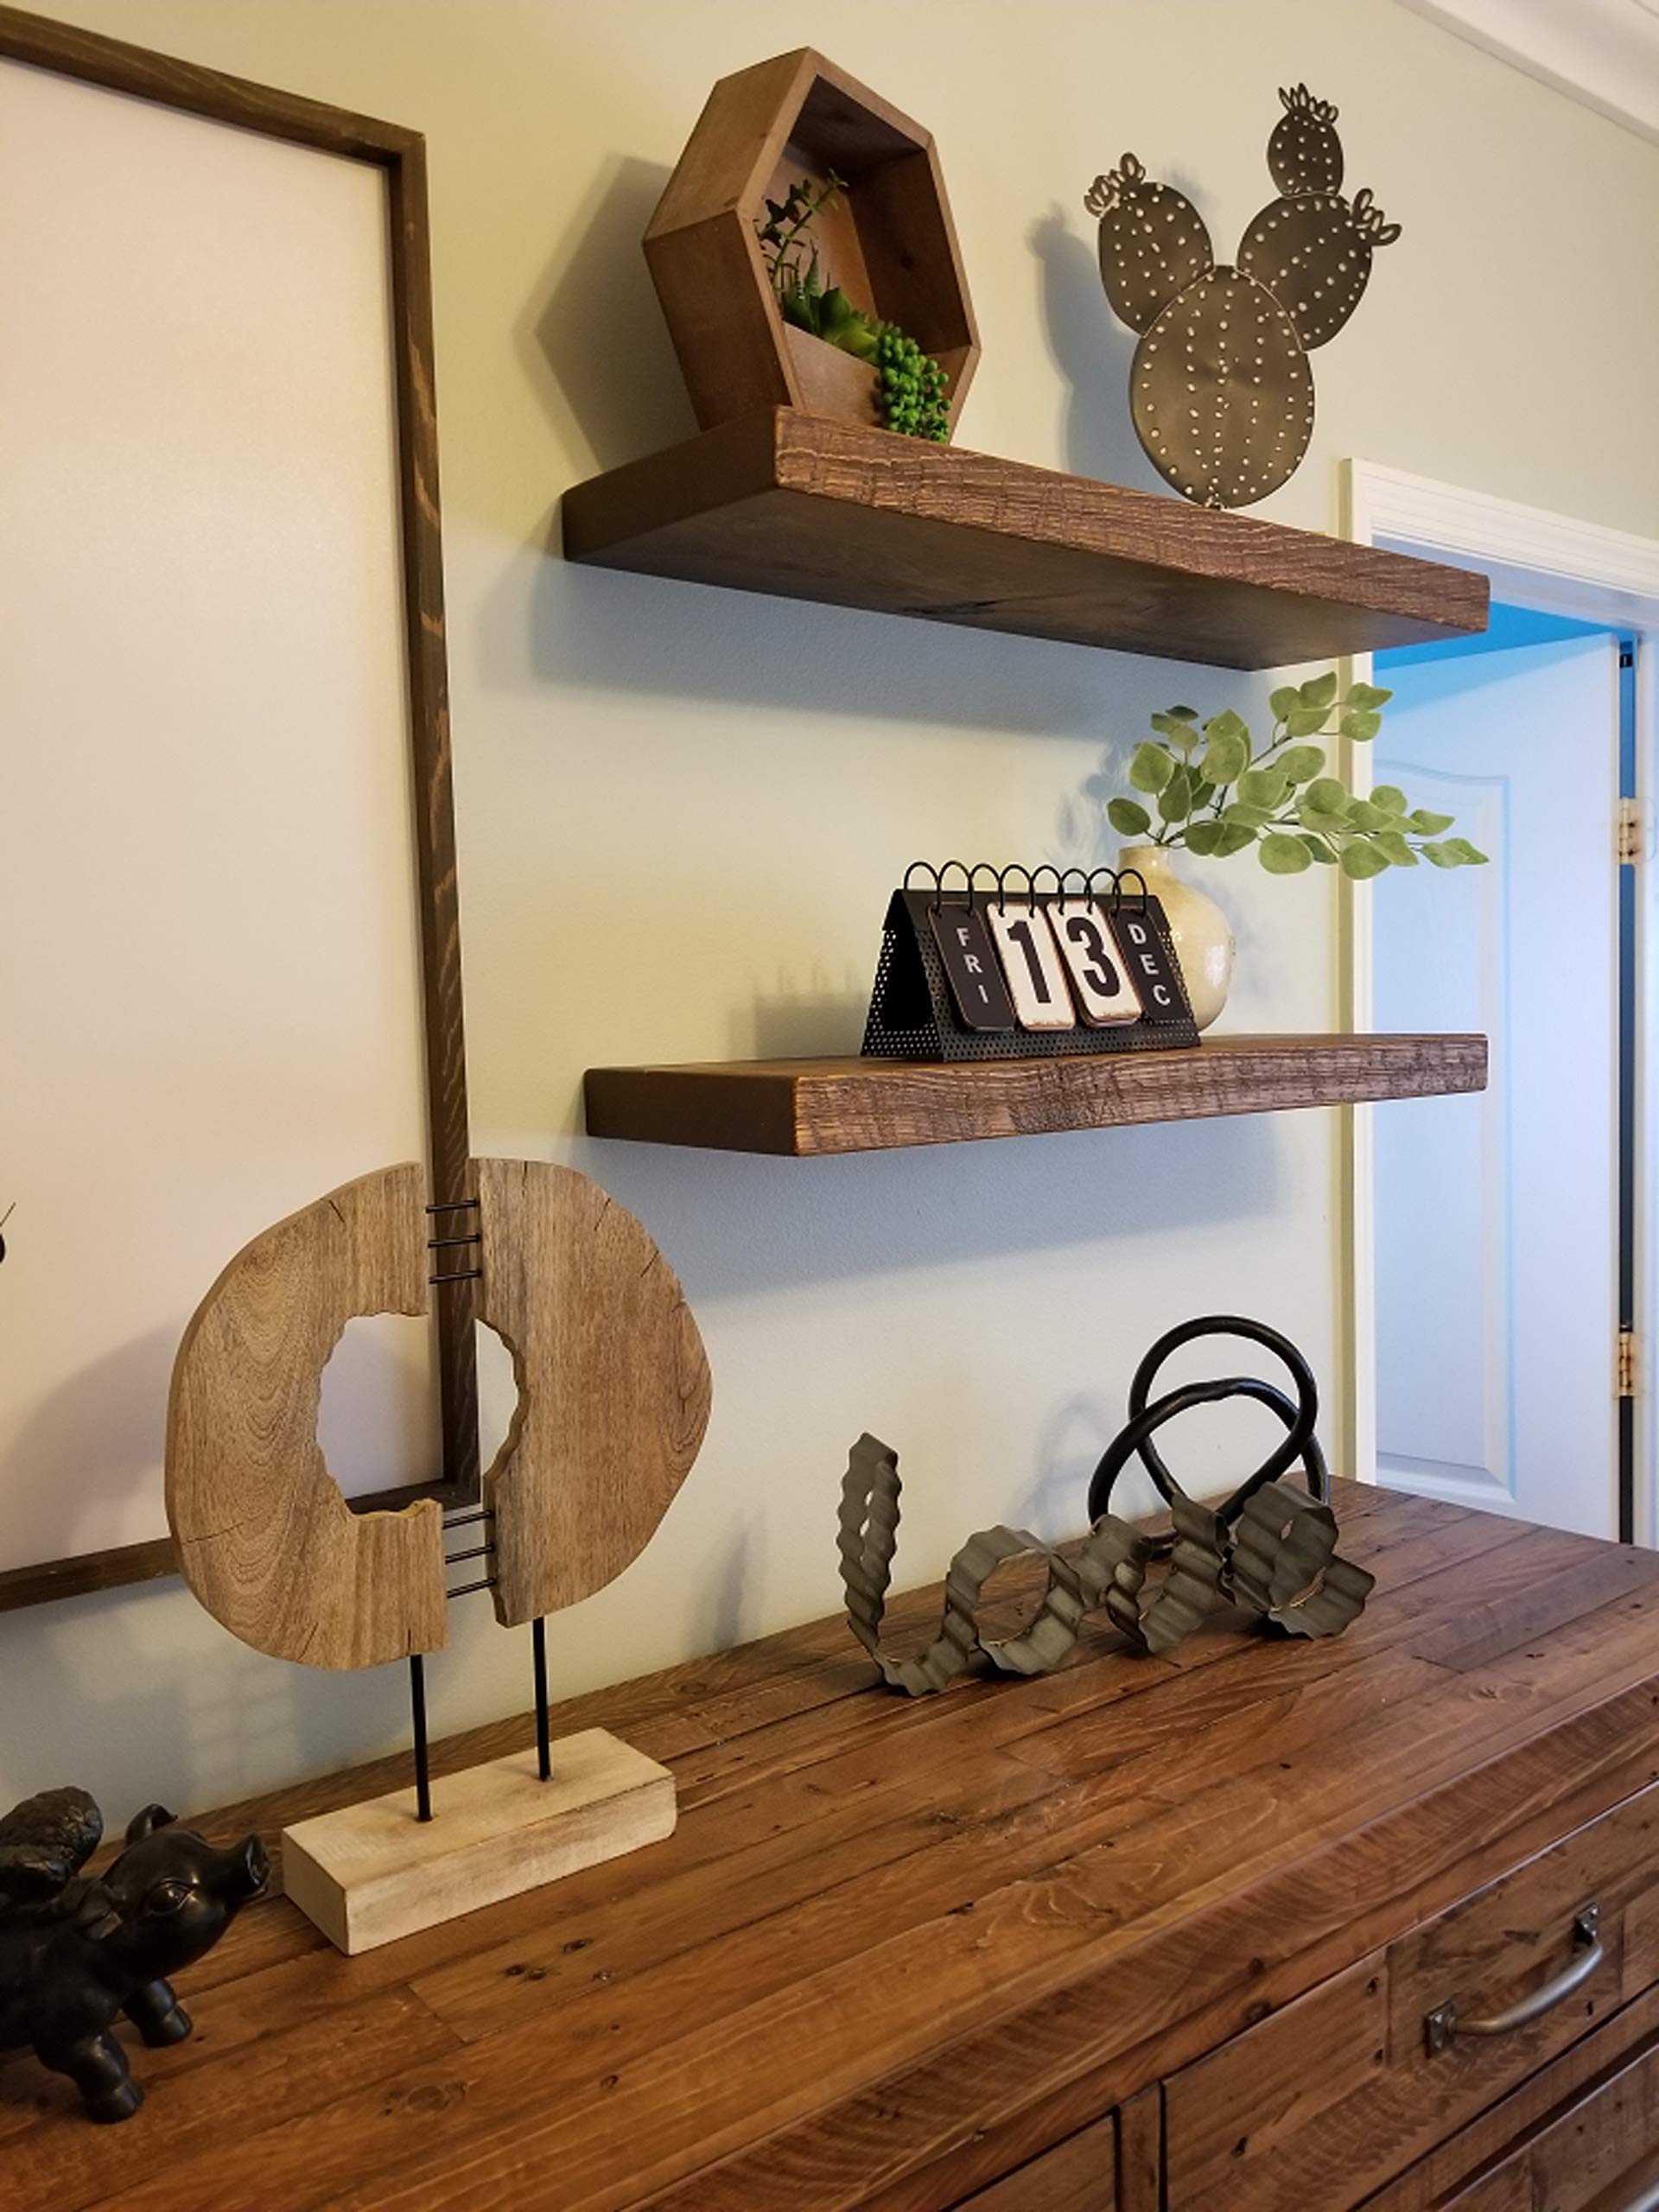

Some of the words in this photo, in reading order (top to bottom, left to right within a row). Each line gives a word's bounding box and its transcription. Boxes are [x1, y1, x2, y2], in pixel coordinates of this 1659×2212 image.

[956, 927, 989, 1003] FRI
[1006, 917, 1121, 1004] 13
[1127, 923, 1171, 1006] DEC
